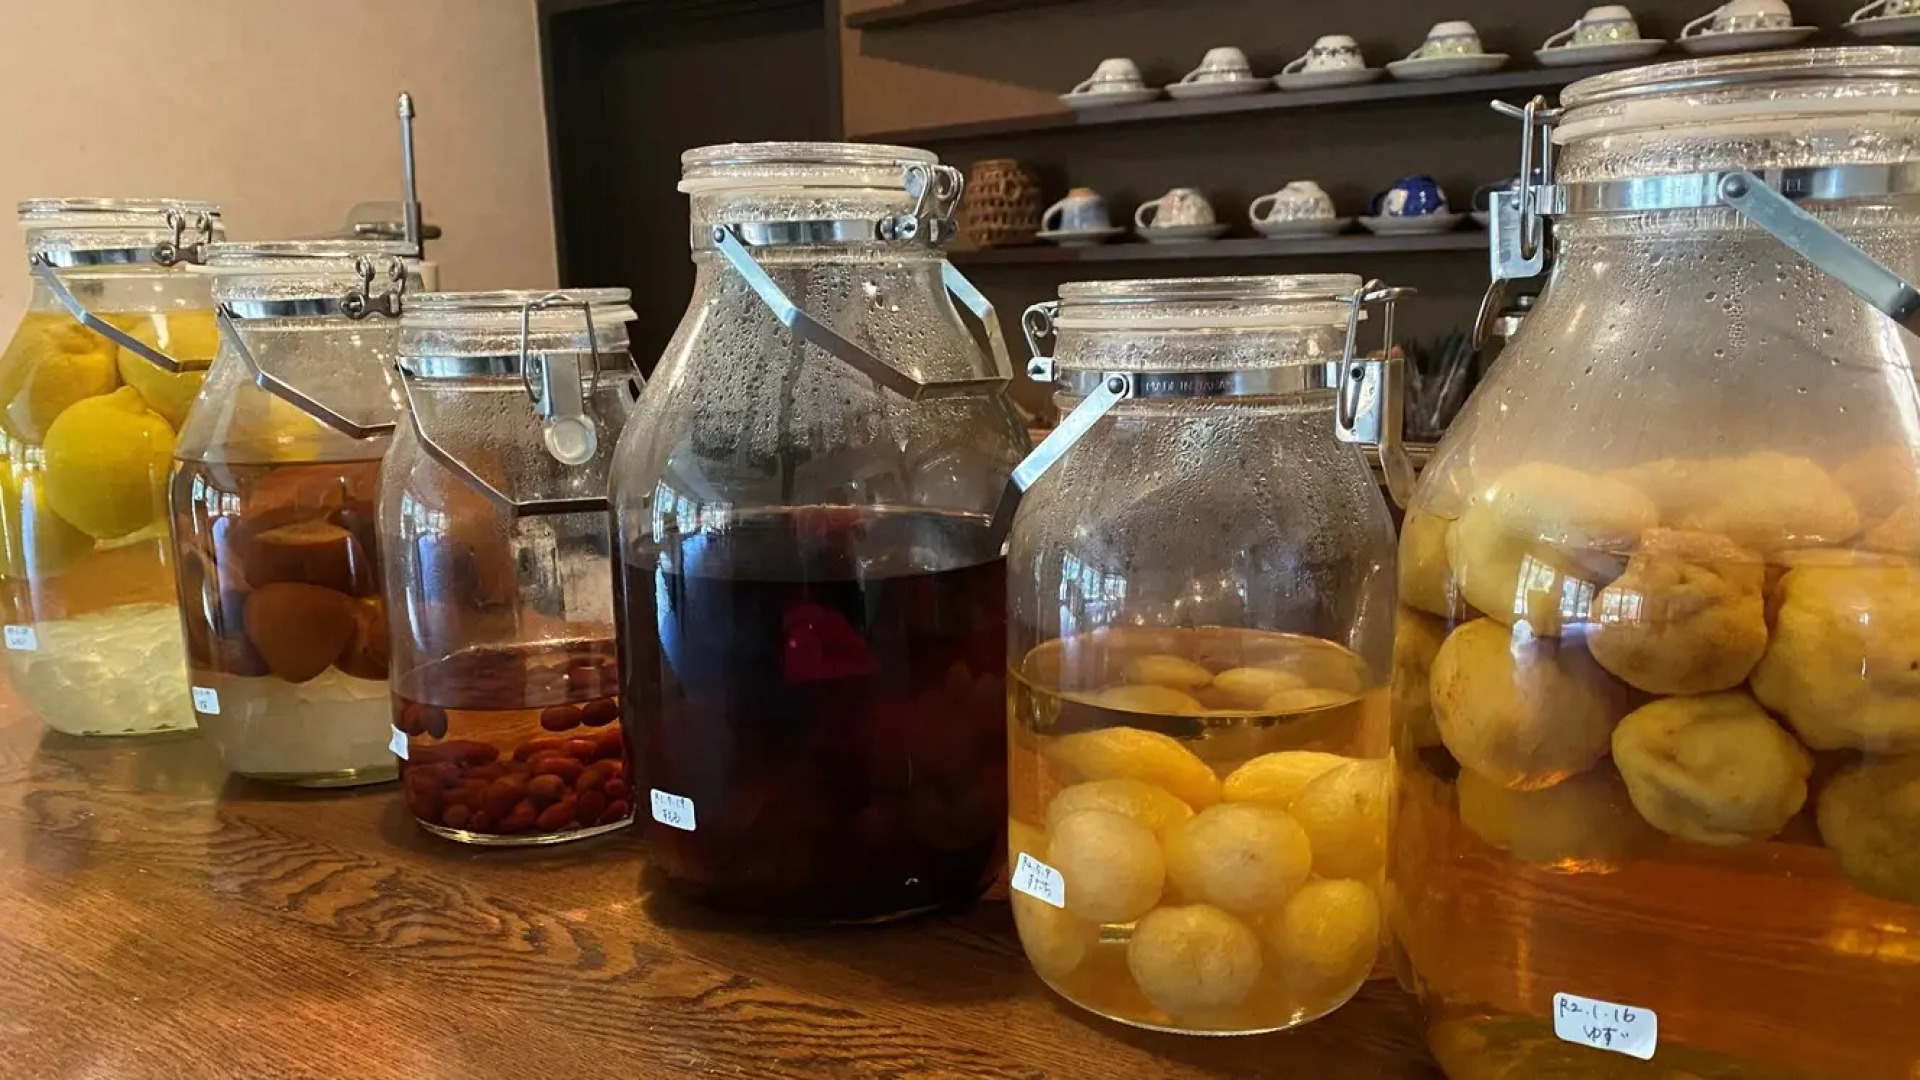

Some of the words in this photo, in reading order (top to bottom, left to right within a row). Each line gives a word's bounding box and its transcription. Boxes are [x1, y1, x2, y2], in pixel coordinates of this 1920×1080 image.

[1145, 381, 1175, 391] MADE
[1180, 381, 1193, 391] IN
[1560, 996, 1637, 1023] R2.1.16
[1582, 1025, 1630, 1046] ゆず
